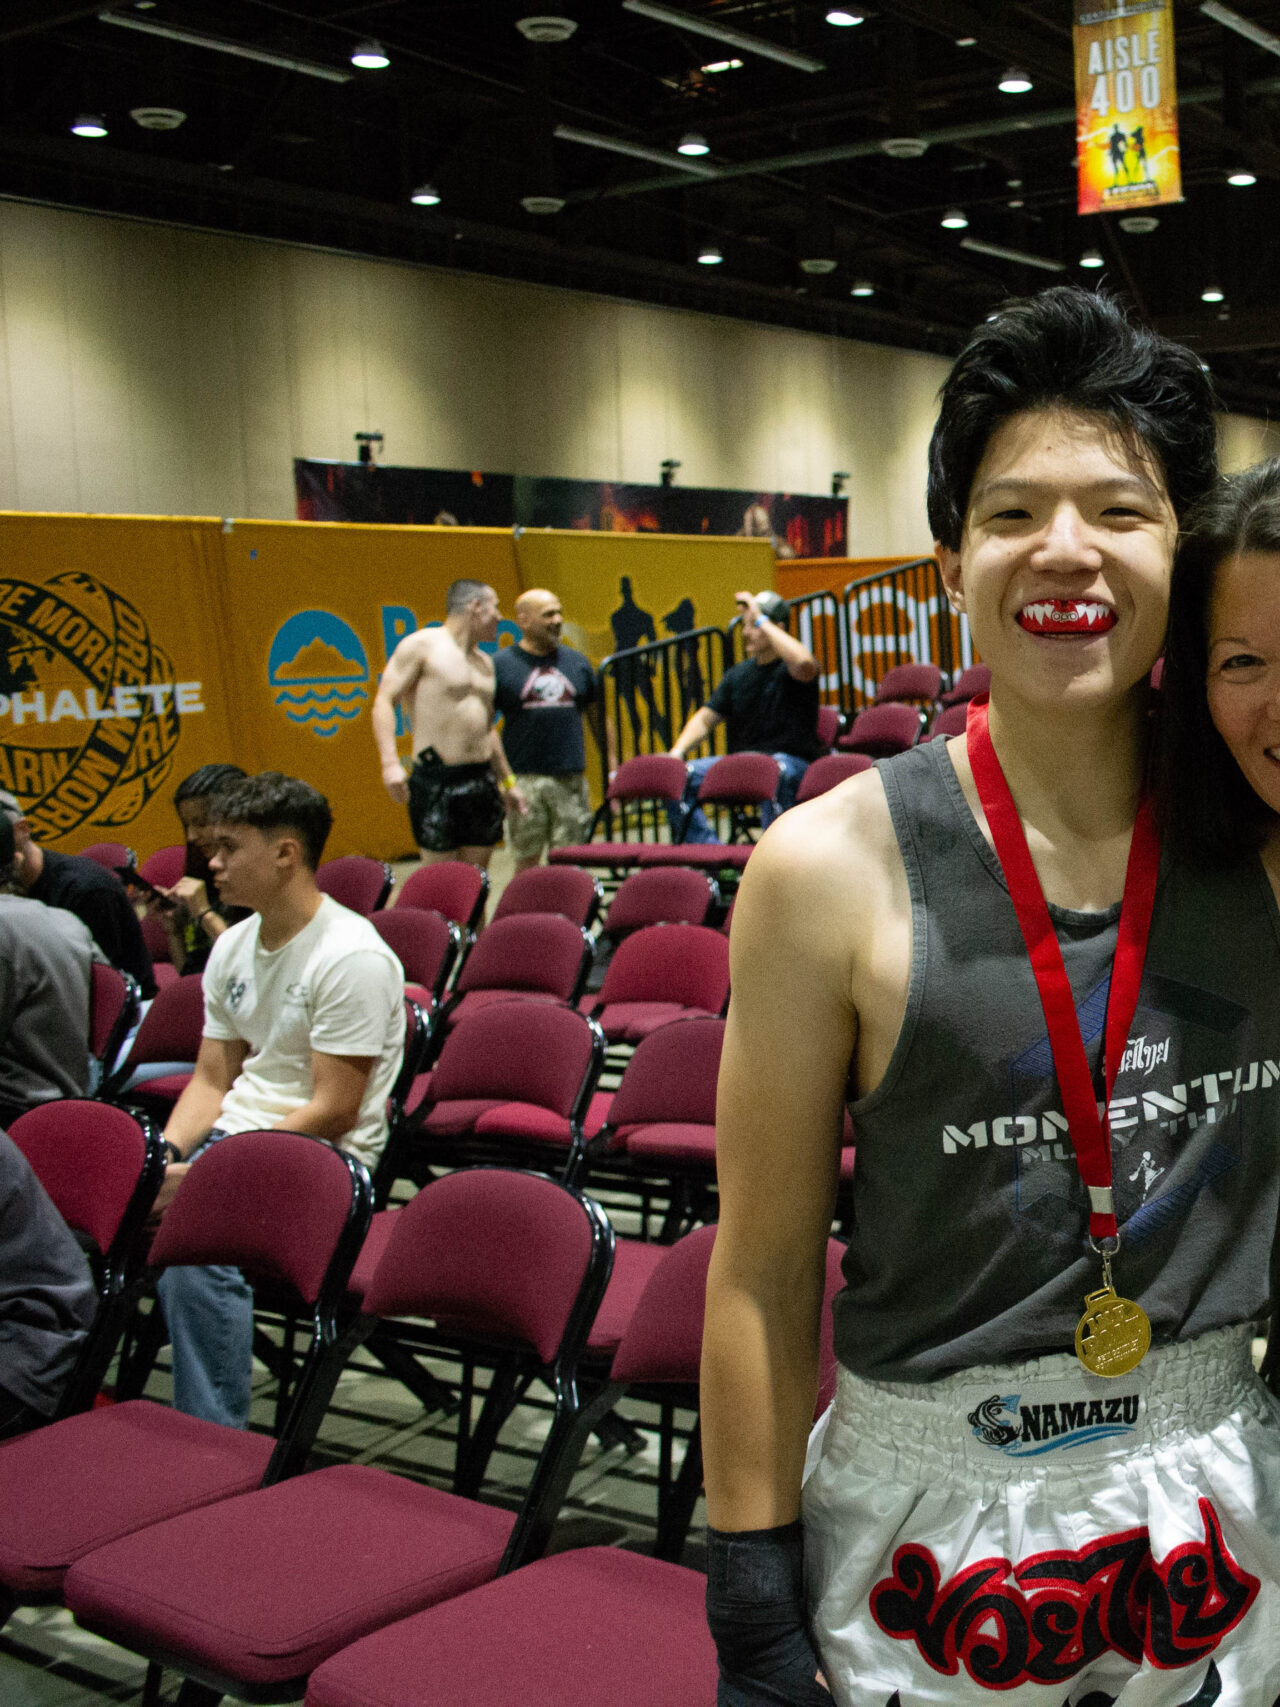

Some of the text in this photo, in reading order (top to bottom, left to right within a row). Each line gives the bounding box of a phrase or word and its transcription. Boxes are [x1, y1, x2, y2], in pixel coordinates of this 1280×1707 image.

[1088, 29, 1160, 75] AISLE
[1091, 65, 1161, 117] 400
[1019, 1394, 1140, 1442] NAMAZU
